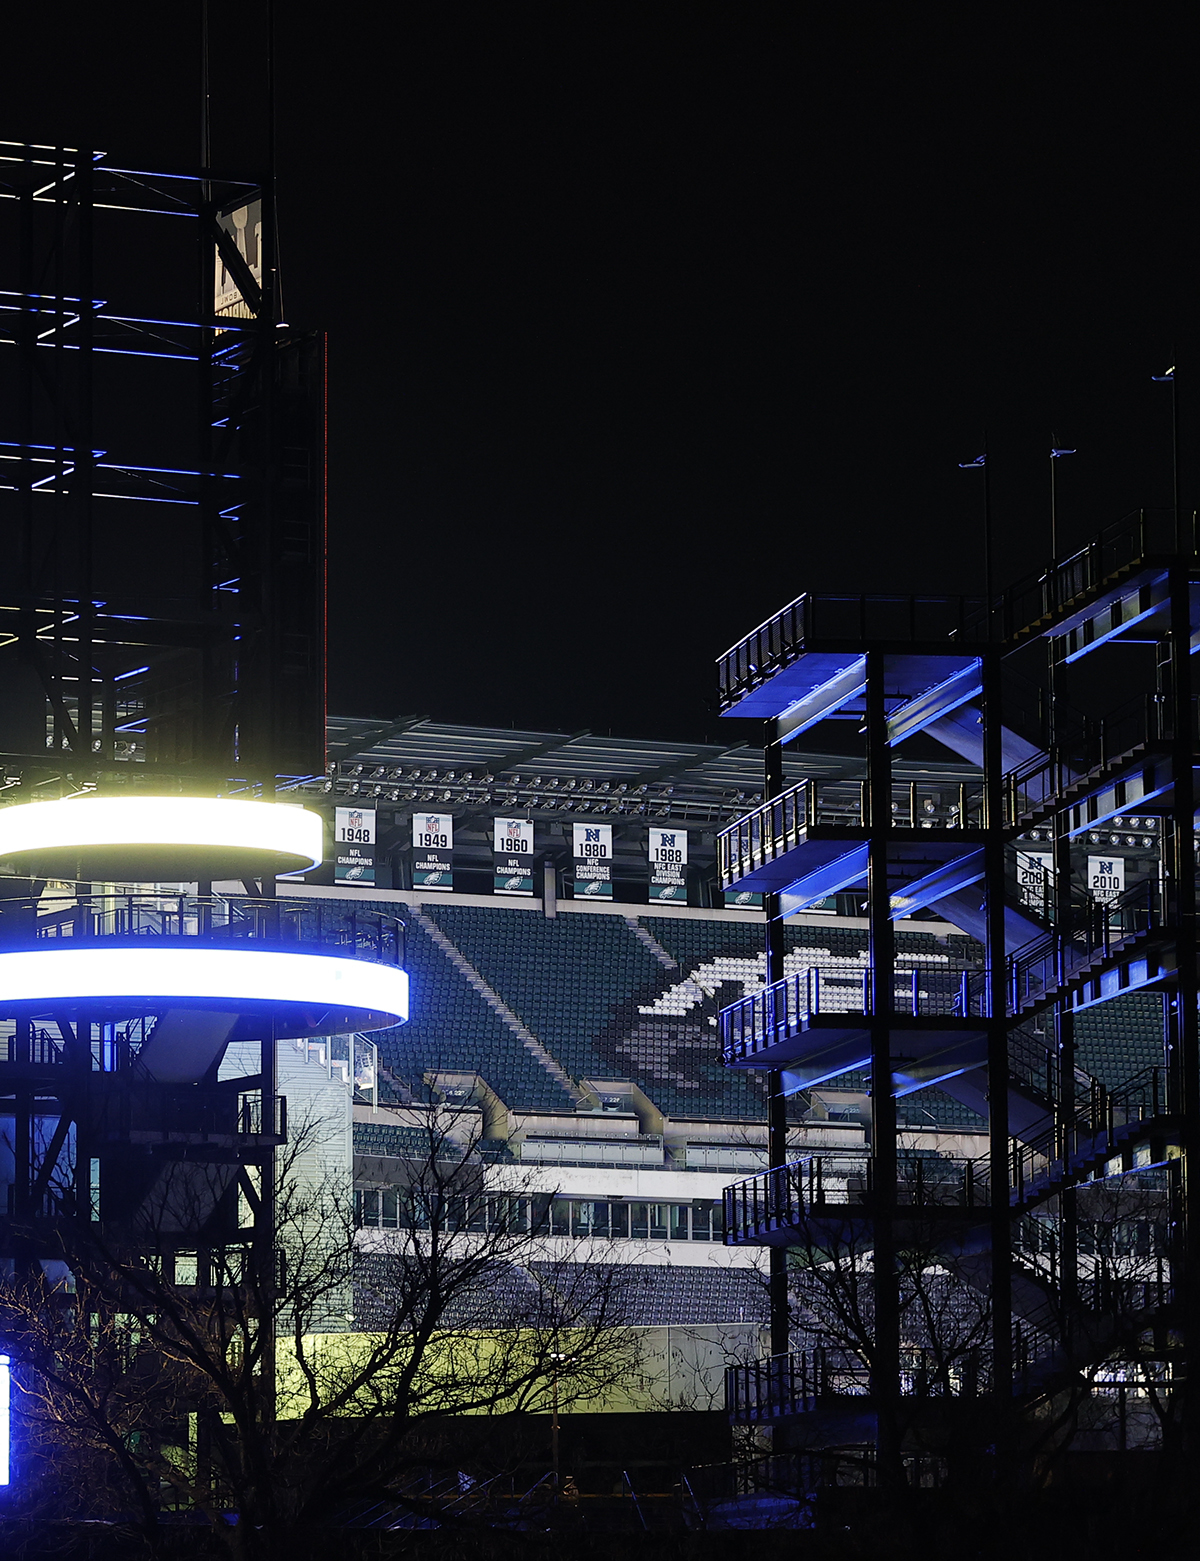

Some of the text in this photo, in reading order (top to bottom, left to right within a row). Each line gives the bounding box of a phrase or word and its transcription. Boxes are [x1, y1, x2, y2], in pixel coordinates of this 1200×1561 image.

[341, 828, 370, 842] 1948
[418, 833, 448, 848] 1949
[500, 838, 528, 852] 1960
[349, 849, 361, 857] NFL
[578, 843, 606, 858] 1980
[654, 848, 682, 862] 1988
[337, 856, 373, 866] CHAMPIONS
[427, 854, 439, 862] NFL
[508, 859, 520, 867] NFL
[416, 862, 450, 871] CHAMPIONS
[496, 866, 531, 876] CHAMPIONS
[576, 865, 610, 874] CONFERENCE
[654, 862, 682, 872] NFC EAST
[576, 872, 610, 880] CHAMPIONS
[656, 870, 681, 878] DIVISION
[651, 876, 686, 886] CHAMPIONS
[1093, 876, 1120, 890] 2010
